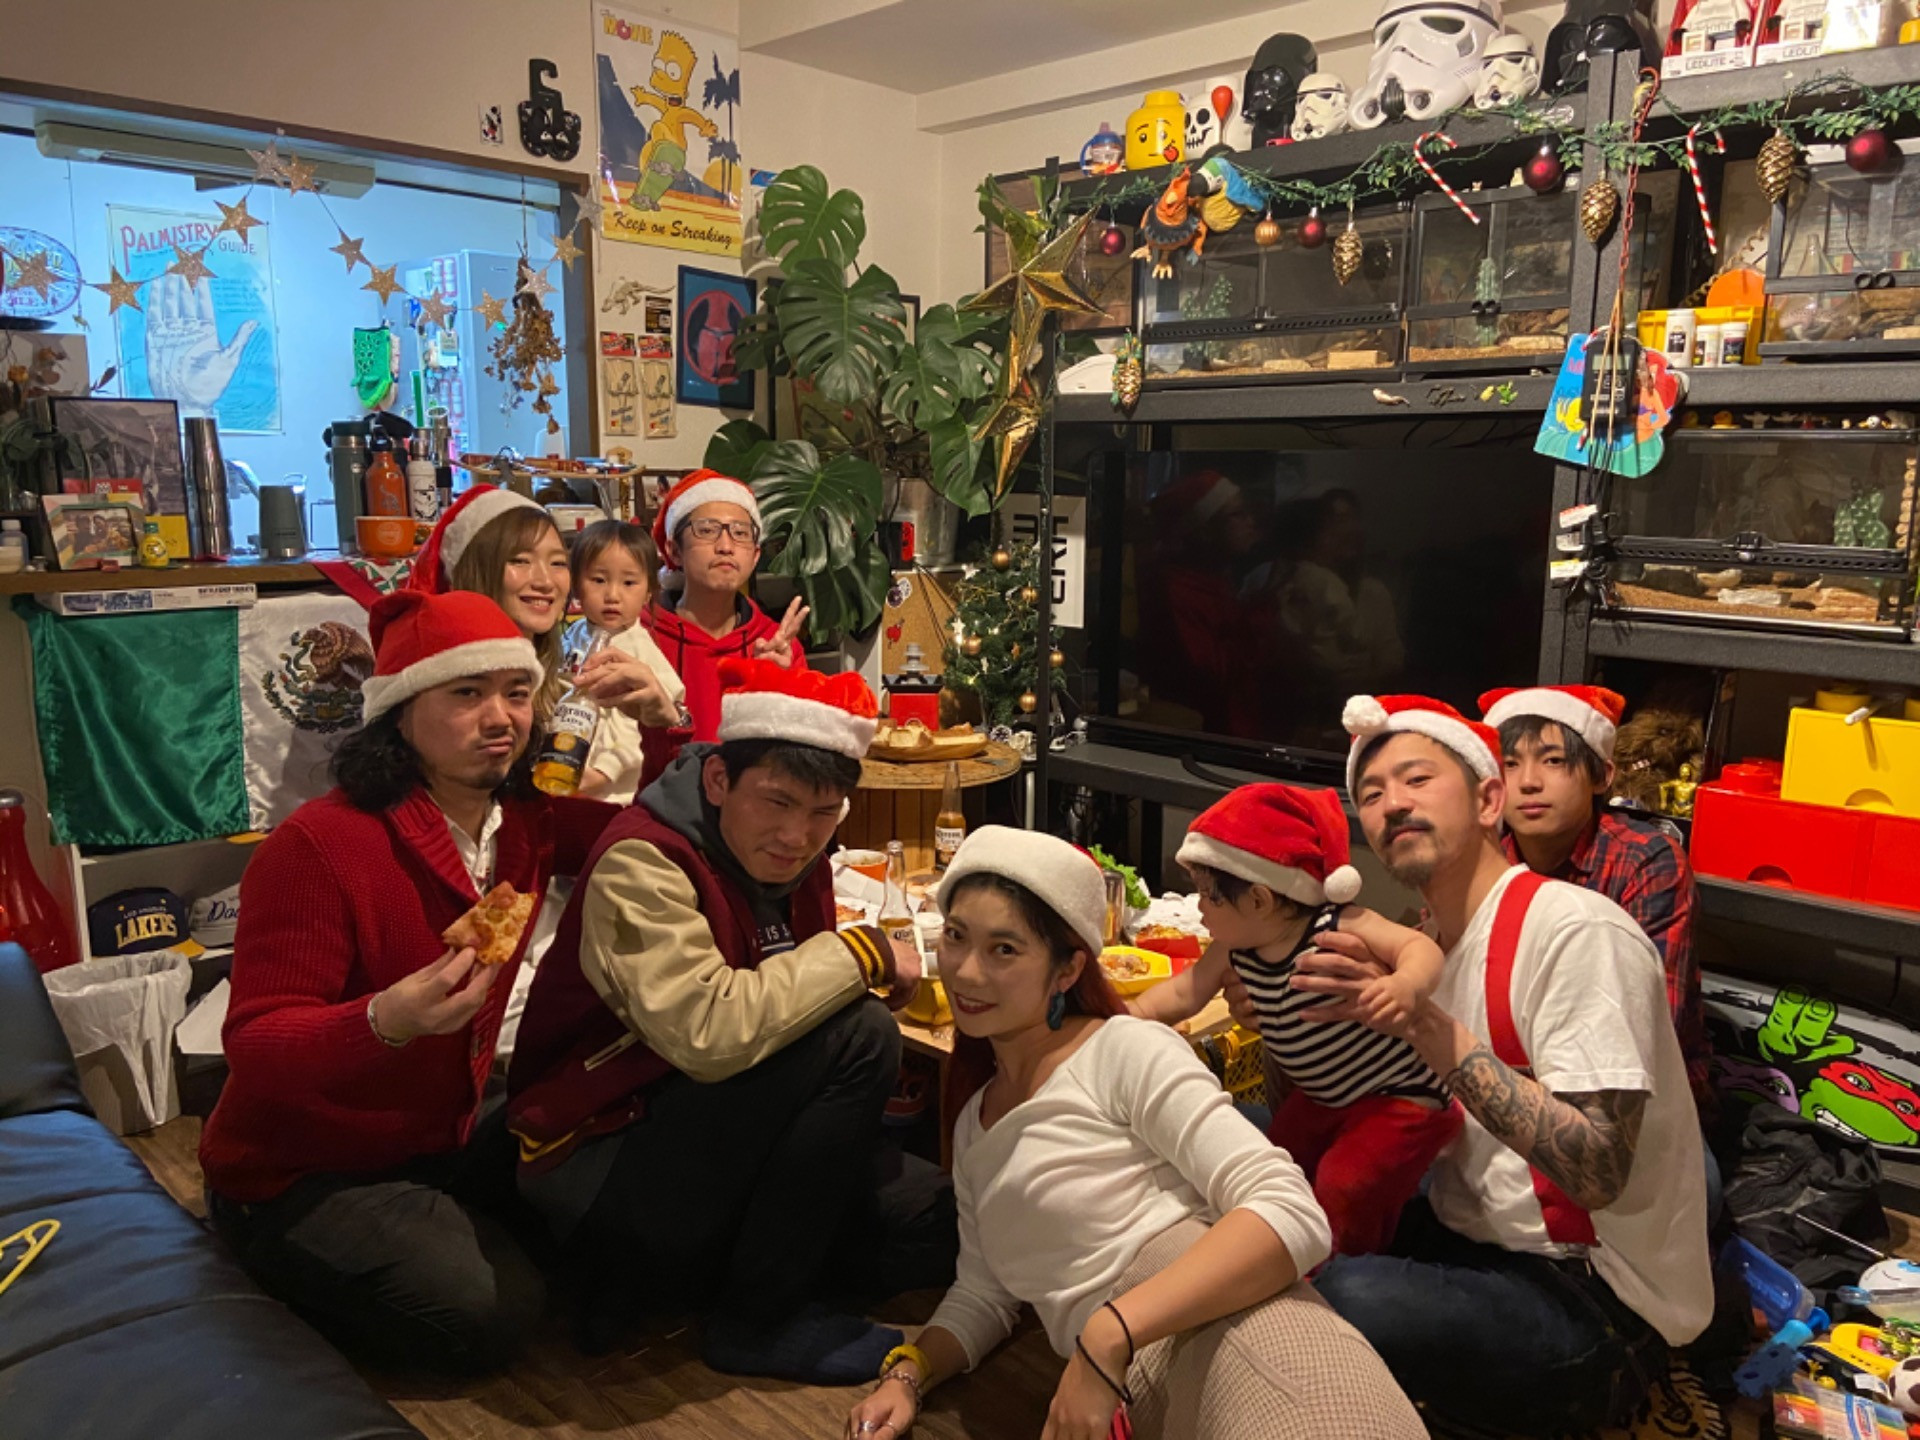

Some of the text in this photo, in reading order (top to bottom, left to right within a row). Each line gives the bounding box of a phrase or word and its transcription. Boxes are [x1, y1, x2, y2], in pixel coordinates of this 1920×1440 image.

[120, 222, 219, 276] PALMISTRY
[613, 210, 732, 250] Keep on Streaking
[115, 913, 178, 949] LAKERS
